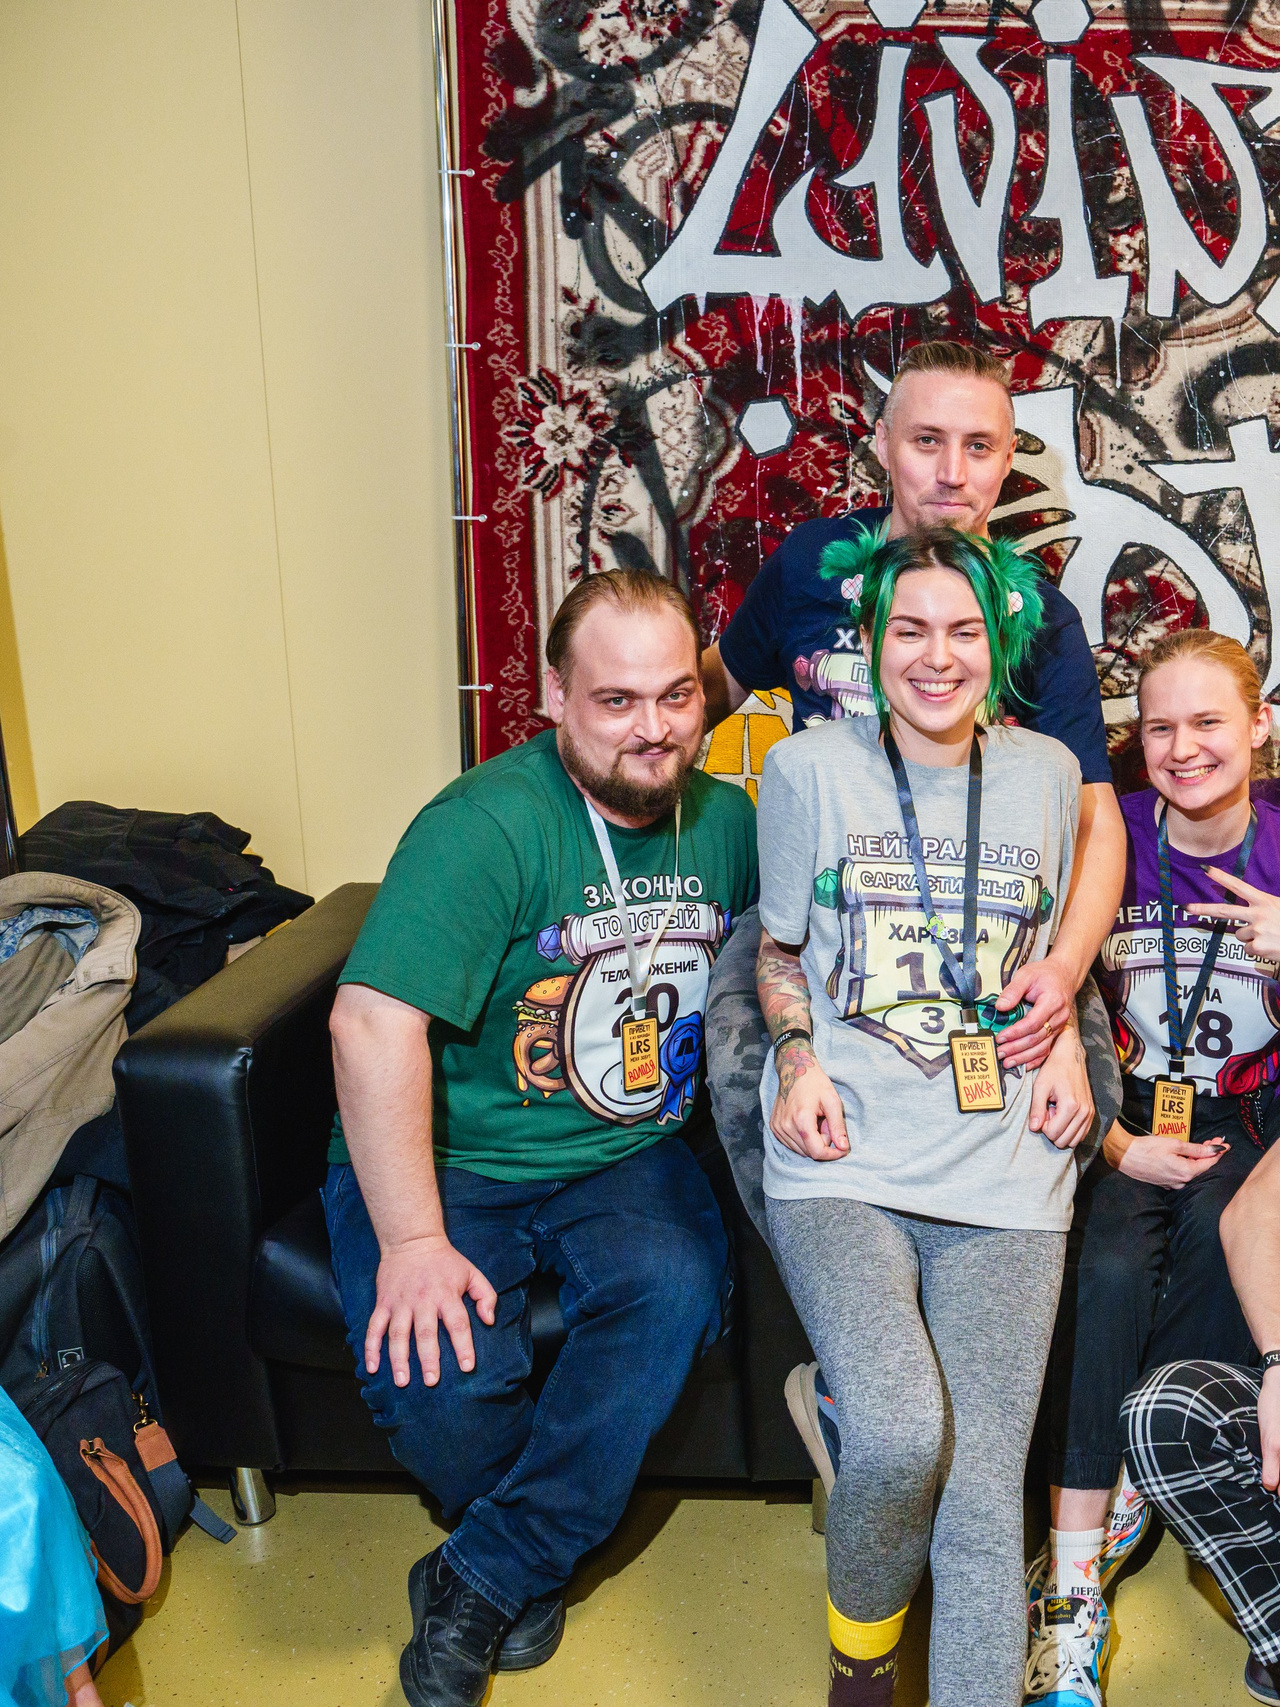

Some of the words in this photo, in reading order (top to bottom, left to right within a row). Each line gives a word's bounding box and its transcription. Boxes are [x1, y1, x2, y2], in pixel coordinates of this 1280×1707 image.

[860, 871, 1025, 901] САРКАСТИНЫЙ
[601, 959, 699, 983] ТЕЛОЖЕНИЕ
[630, 1039, 651, 1056] LRS
[962, 1057, 989, 1073] LRS
[963, 1080, 997, 1104] ВИКА
[1161, 1099, 1184, 1114] LRS
[1155, 1121, 1187, 1136] МАША
